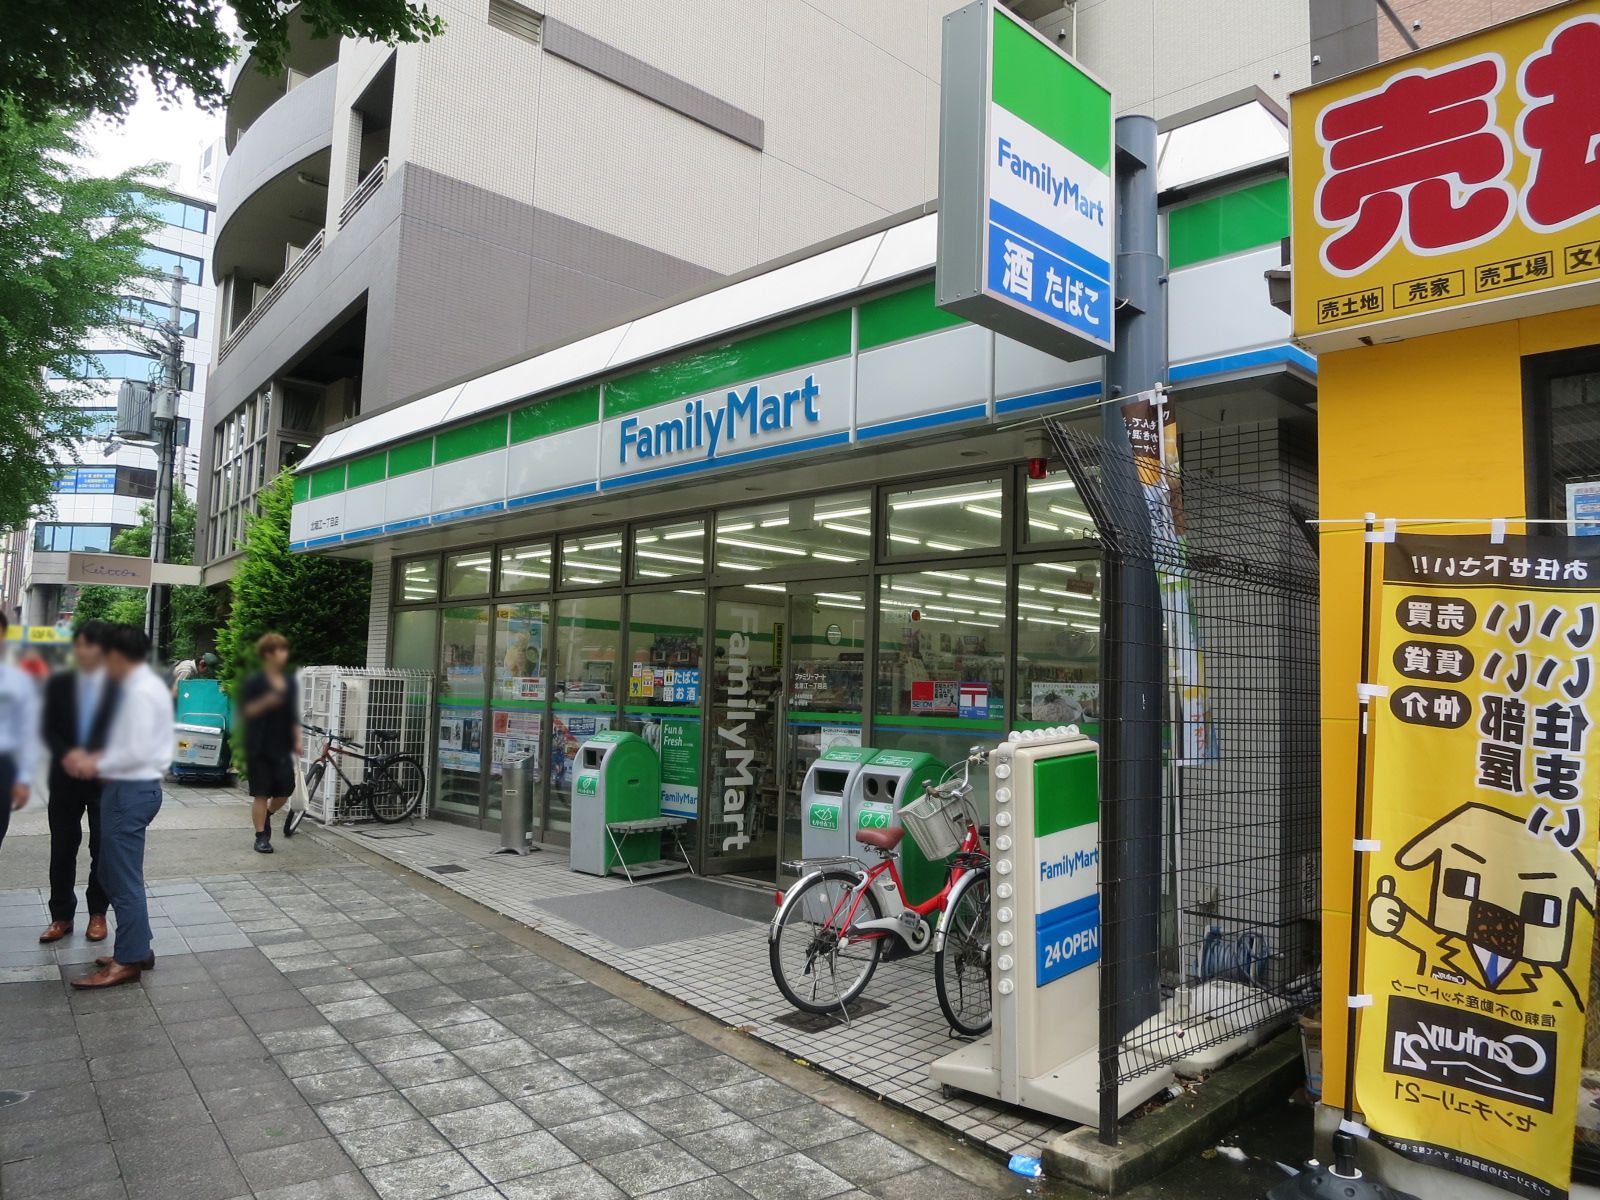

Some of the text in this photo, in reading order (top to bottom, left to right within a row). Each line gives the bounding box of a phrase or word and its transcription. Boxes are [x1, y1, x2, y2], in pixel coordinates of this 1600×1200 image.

[998, 137, 1104, 226] FamilyMart
[1003, 239, 1099, 325] 酒 たばこ
[1321, 292, 1380, 320] 売土地
[1408, 277, 1451, 302] 売家
[1479, 259, 1549, 288] 売工場
[619, 373, 820, 464] FamilyMart
[674, 670, 699, 685] たばこ
[675, 687, 696, 701] お酒
[794, 673, 828, 682] ファミリーマート
[663, 736, 683, 747] Fresh
[664, 724, 678, 735] Fun
[718, 607, 760, 852] FamilyMart
[1040, 848, 1099, 882] FamilyMart
[1044, 926, 1098, 969] 24 OPEN
